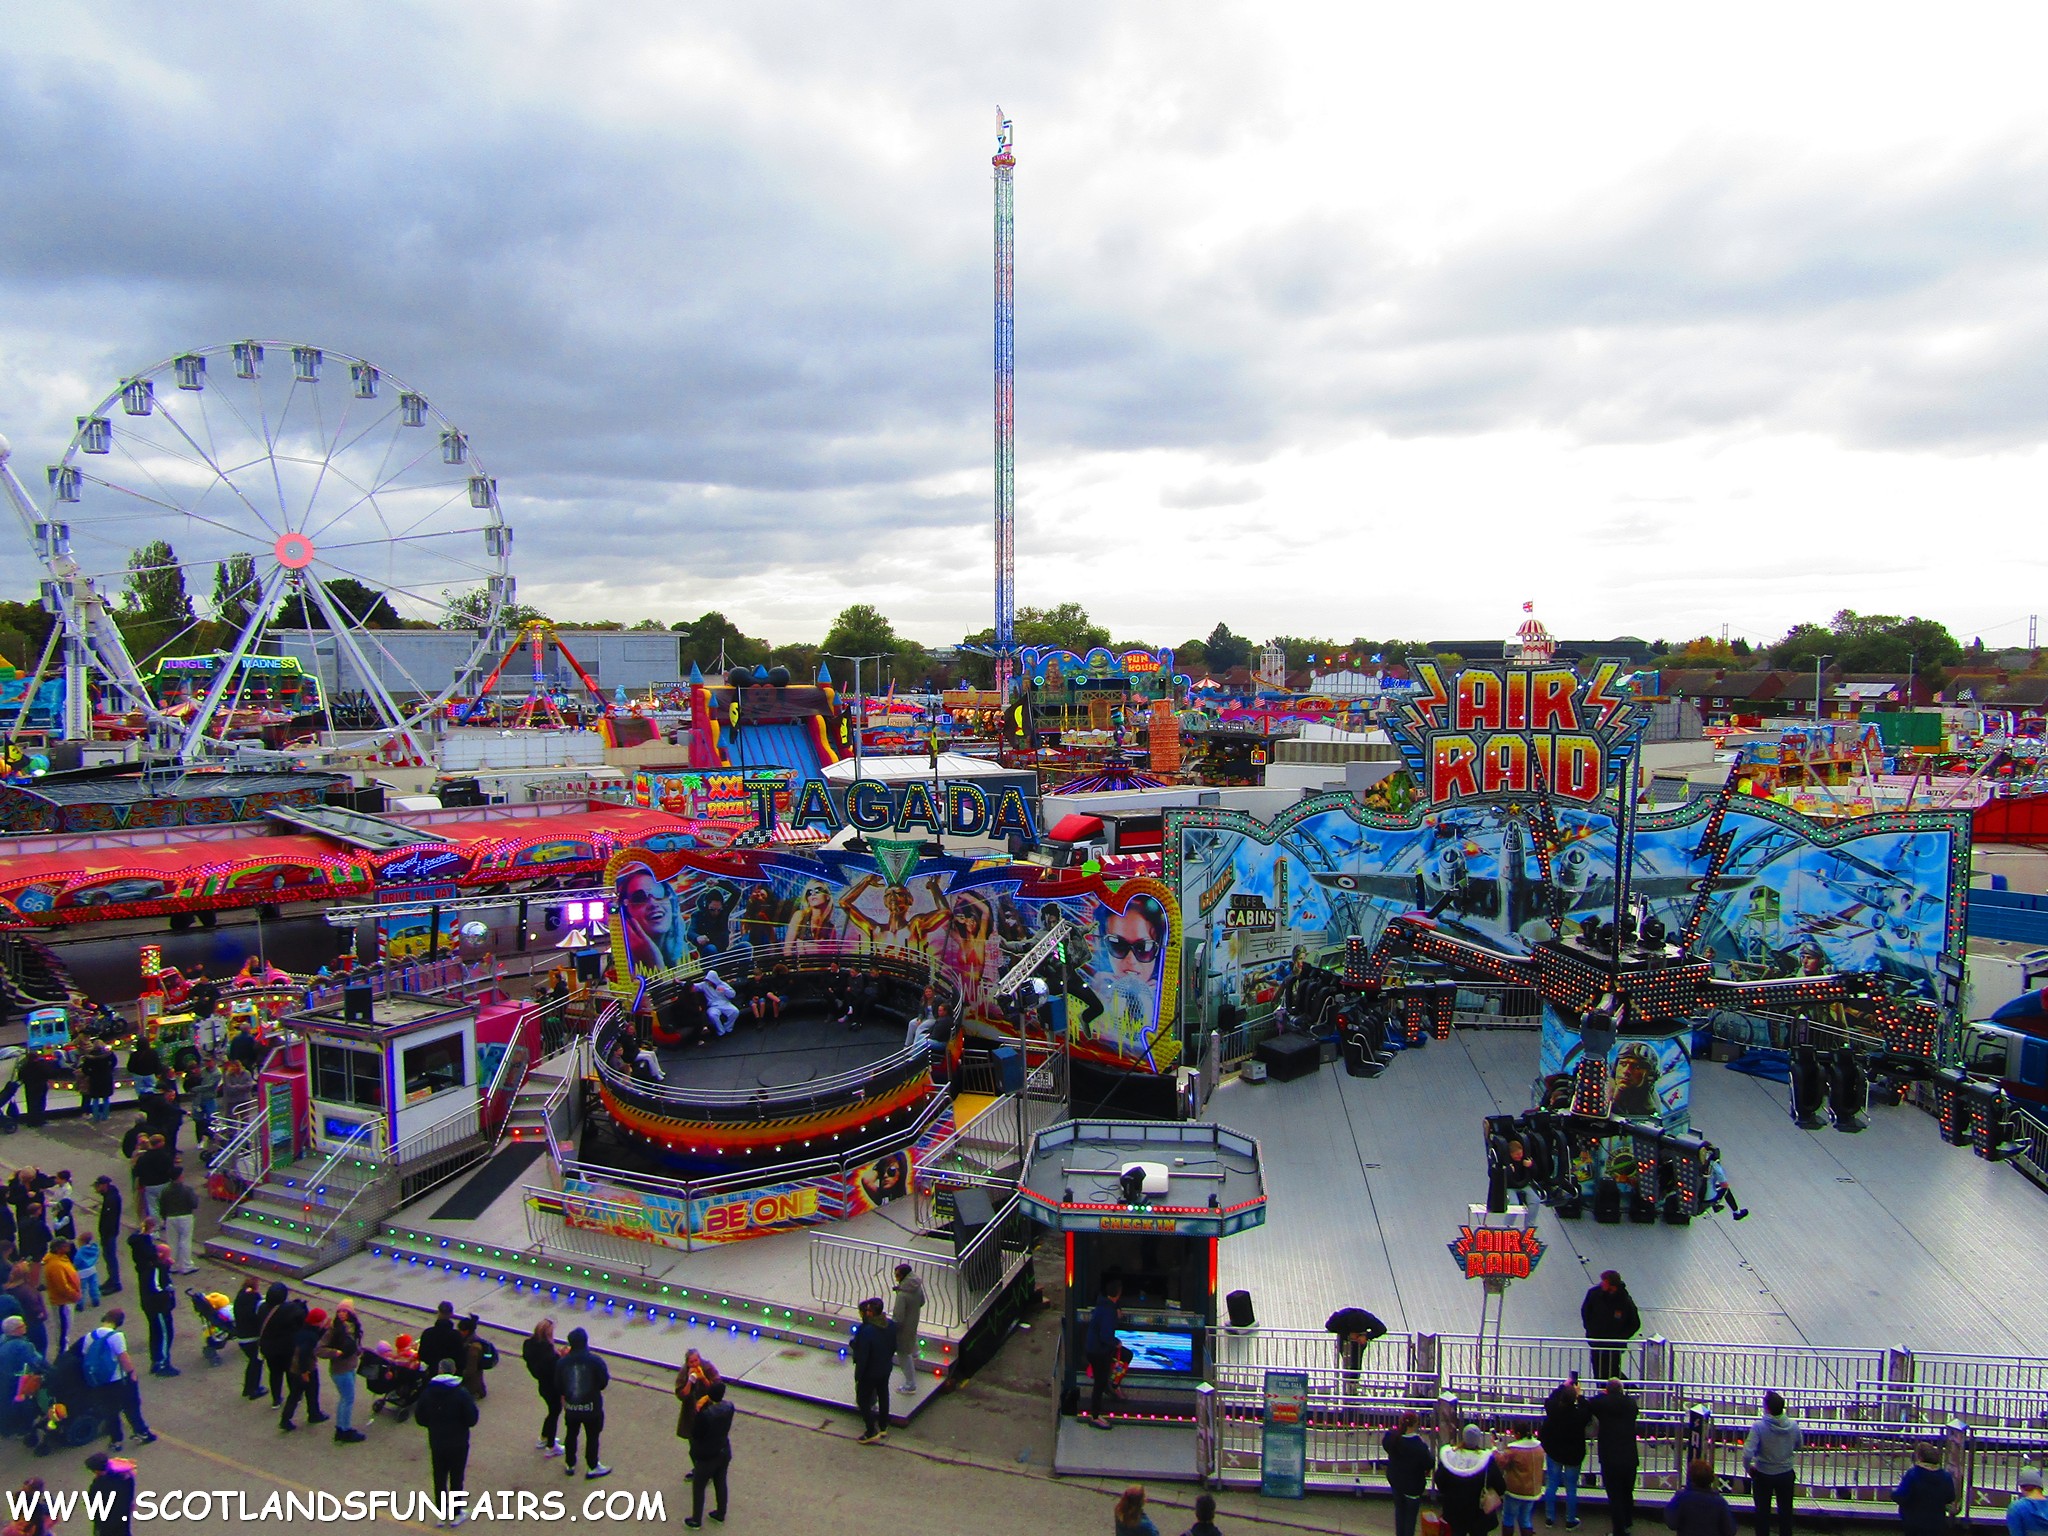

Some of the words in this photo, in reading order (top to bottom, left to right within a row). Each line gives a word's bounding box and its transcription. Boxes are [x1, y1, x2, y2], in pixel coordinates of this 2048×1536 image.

[164, 660, 213, 669] JUNGLE
[242, 660, 296, 669] MADNESS
[1127, 654, 1148, 663] FUN
[1128, 663, 1160, 672] HOUSE
[1455, 667, 1580, 731] AIR
[1431, 733, 1602, 805] RAID
[741, 777, 1041, 846] TAGADA
[28, 883, 58, 896] ROUTE
[381, 891, 411, 904] DRIVE
[414, 889, 432, 901] ALL
[435, 887, 453, 899] DAY
[22, 897, 46, 912] 66
[1233, 895, 1257, 908] CAFE
[1226, 909, 1275, 926] CABINS
[621, 1202, 685, 1237] ONLY
[704, 1200, 749, 1236] BE
[752, 1186, 821, 1224] ONE
[1100, 1216, 1153, 1231] CHECK
[1156, 1218, 1176, 1232] IN
[1475, 1229, 1522, 1252] AIR
[1466, 1252, 1530, 1279] RAID
